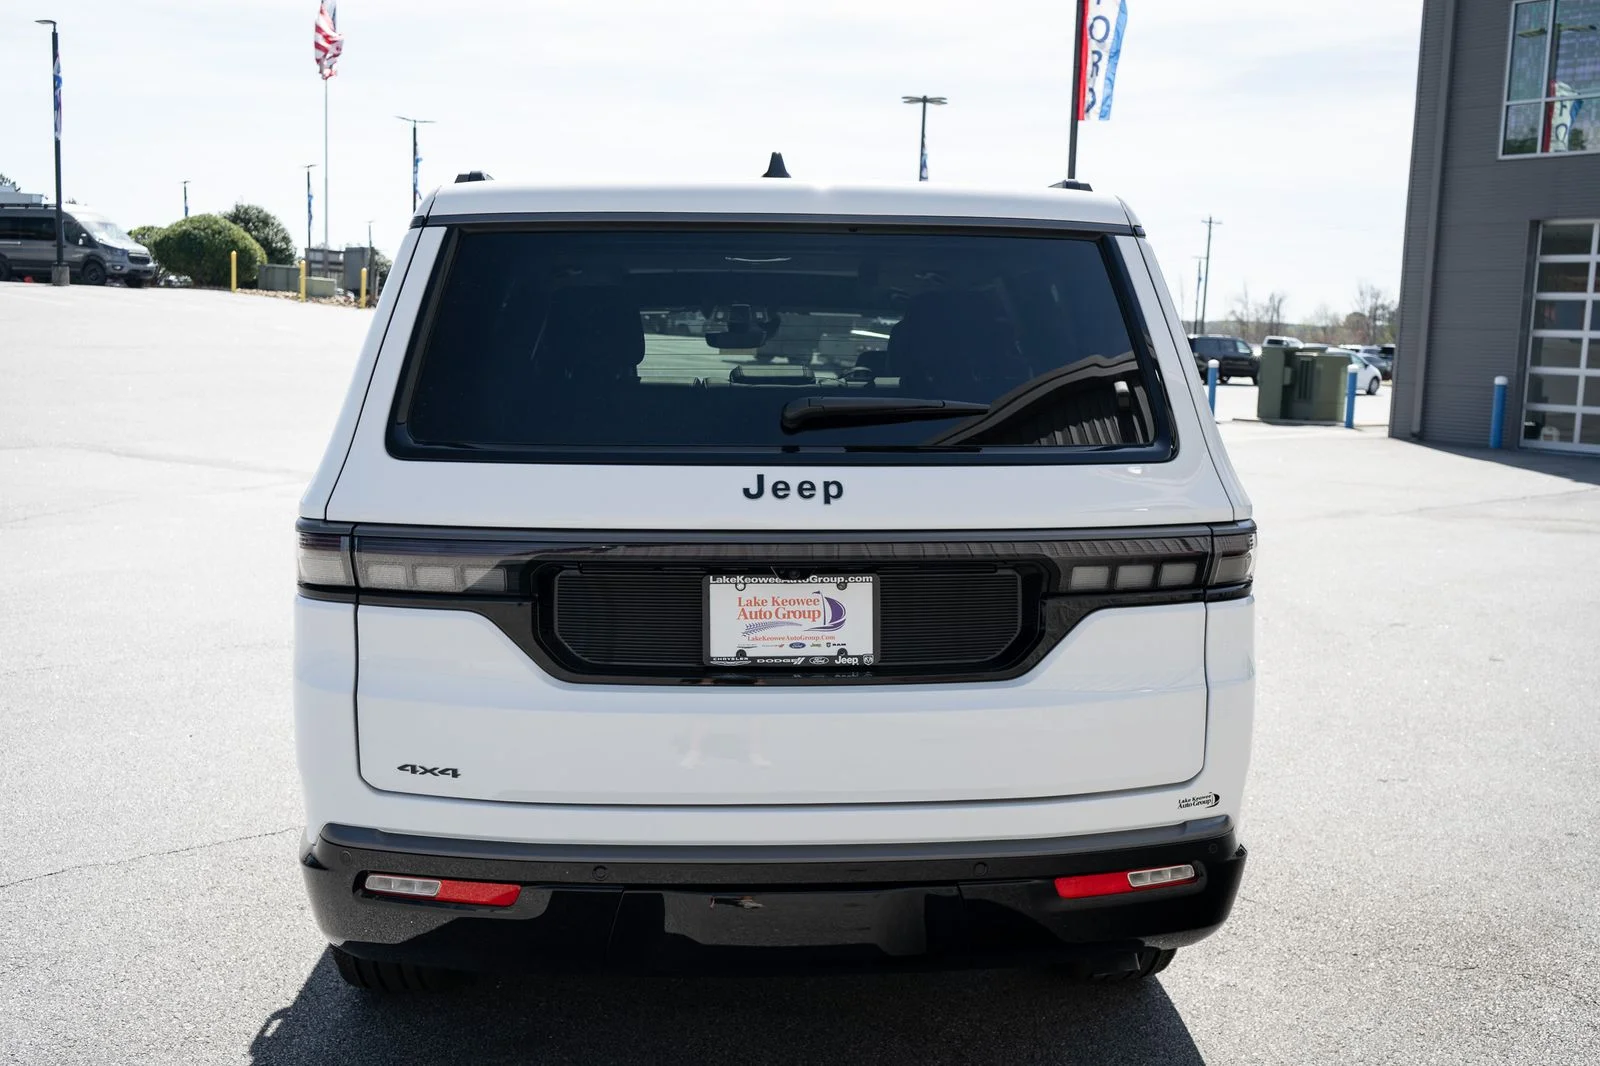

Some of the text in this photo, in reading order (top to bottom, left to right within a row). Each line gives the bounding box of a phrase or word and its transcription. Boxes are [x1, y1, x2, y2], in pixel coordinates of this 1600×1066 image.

[1084, 0, 1110, 113] ORD
[742, 473, 844, 505] Jeep
[737, 596, 820, 607] Lake Keowee
[737, 606, 821, 622] Auto Group
[834, 656, 859, 665] Jeep
[397, 764, 461, 778] 4x4
